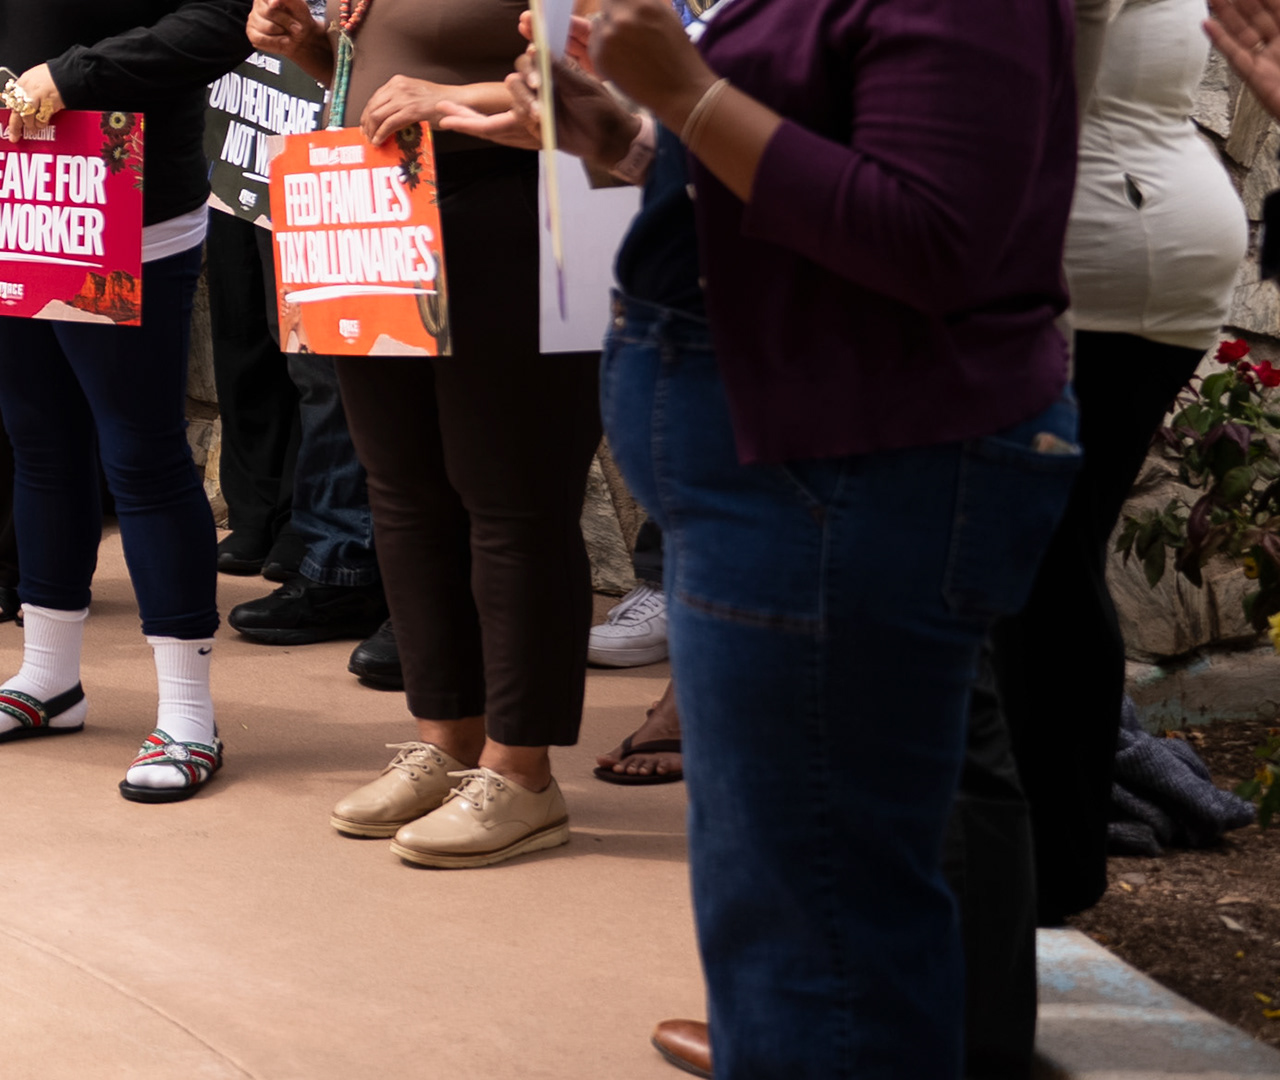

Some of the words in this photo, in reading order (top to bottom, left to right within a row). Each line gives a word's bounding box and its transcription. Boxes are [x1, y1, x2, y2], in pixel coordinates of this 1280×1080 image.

[207, 71, 241, 116] UND
[240, 76, 321, 136] HEALTHCARE
[220, 120, 256, 169] NOT
[55, 155, 107, 205] FOR
[283, 172, 322, 227] FEED
[319, 165, 412, 225] FAMILIES
[276, 230, 308, 284] TAX
[305, 225, 438, 284] BILLIONAIRES
